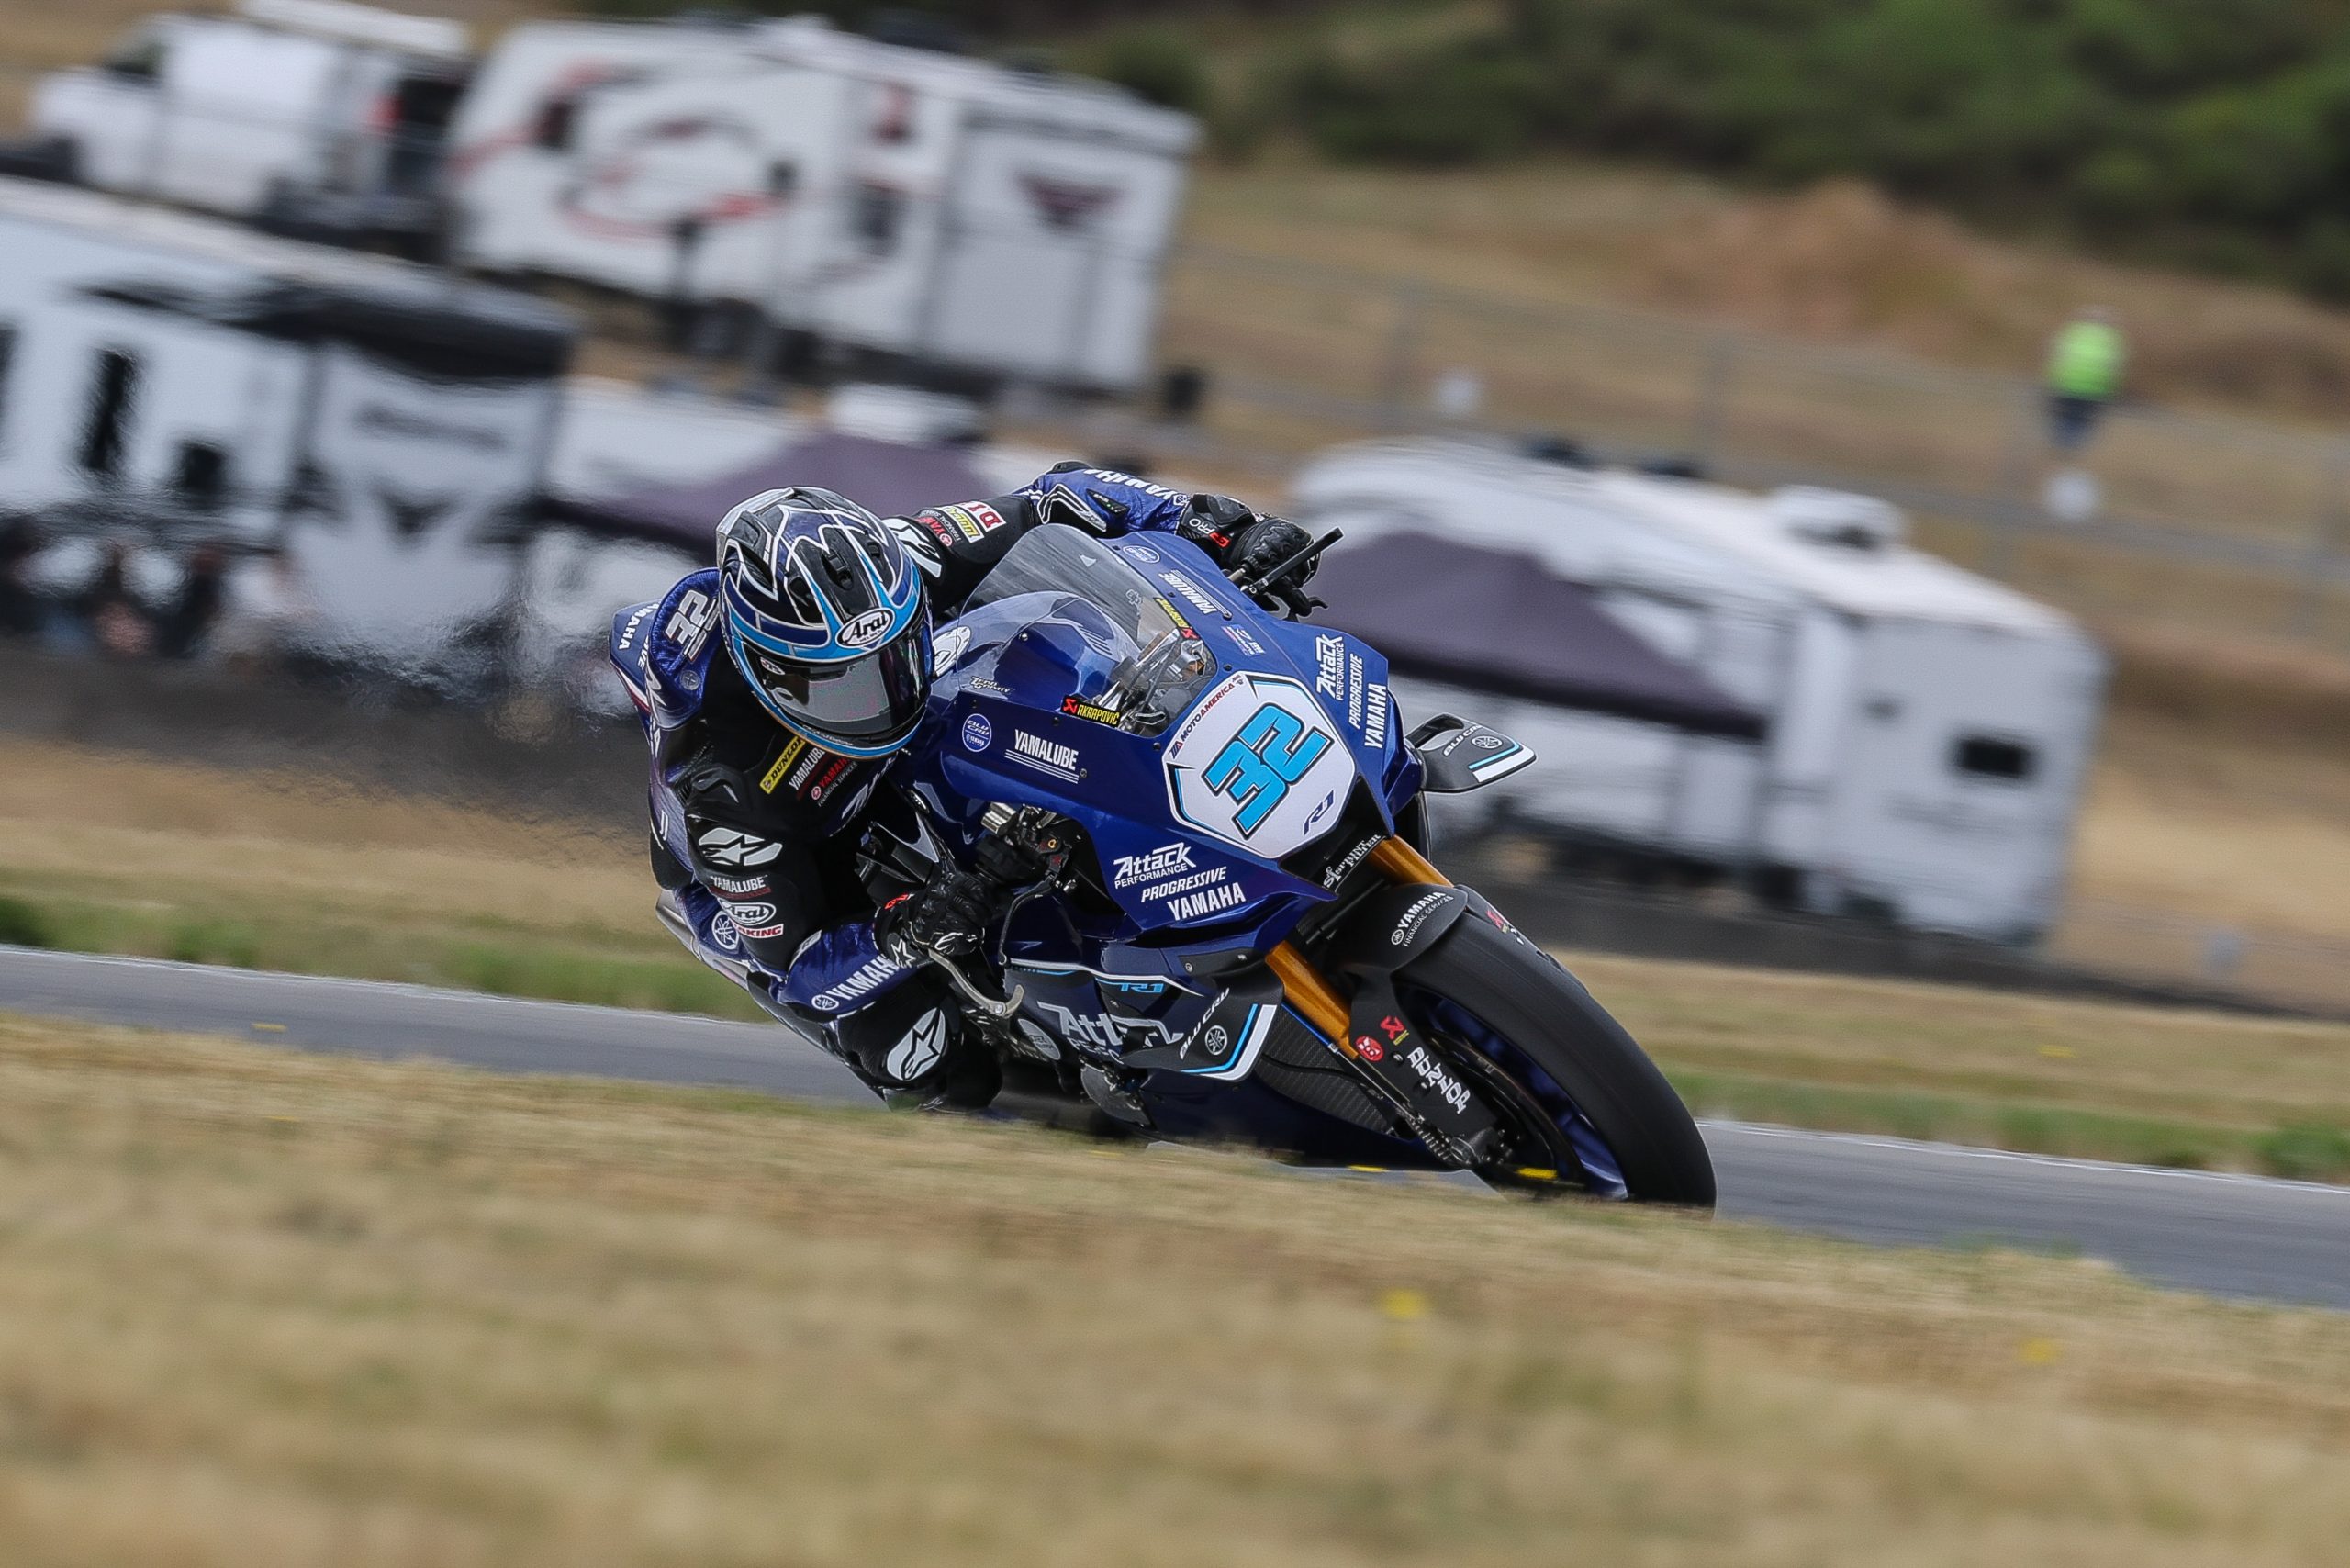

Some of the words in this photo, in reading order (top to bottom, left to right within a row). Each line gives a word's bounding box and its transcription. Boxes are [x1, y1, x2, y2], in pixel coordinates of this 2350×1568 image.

[1189, 518, 1215, 536] PRO
[1158, 573, 1218, 614] YAMALUBE
[618, 602, 661, 650] AMAHA
[843, 610, 889, 644] Arai
[1336, 643, 1345, 701] PERFORMANCE
[1348, 653, 1363, 730] PROGRESSIVE
[1180, 682, 1236, 742] MOTOAMERICA
[1364, 683, 1387, 749] YAMAHA
[1013, 729, 1080, 772] YAMALUBE
[818, 757, 851, 790] YAMAH
[1200, 701, 1336, 841] 32
[1303, 790, 1335, 837] R1
[1113, 842, 1197, 881] Attack
[1114, 863, 1188, 890] PERFORMANCE
[710, 874, 769, 893] YAMALUBE
[1140, 866, 1227, 903] PROGRESSIVE
[1166, 882, 1247, 921] YAMAHA
[1397, 891, 1447, 929] YAMAHA
[1404, 913, 1427, 947] FINANCIAL
[1406, 1046, 1471, 1114] DUNLOP
